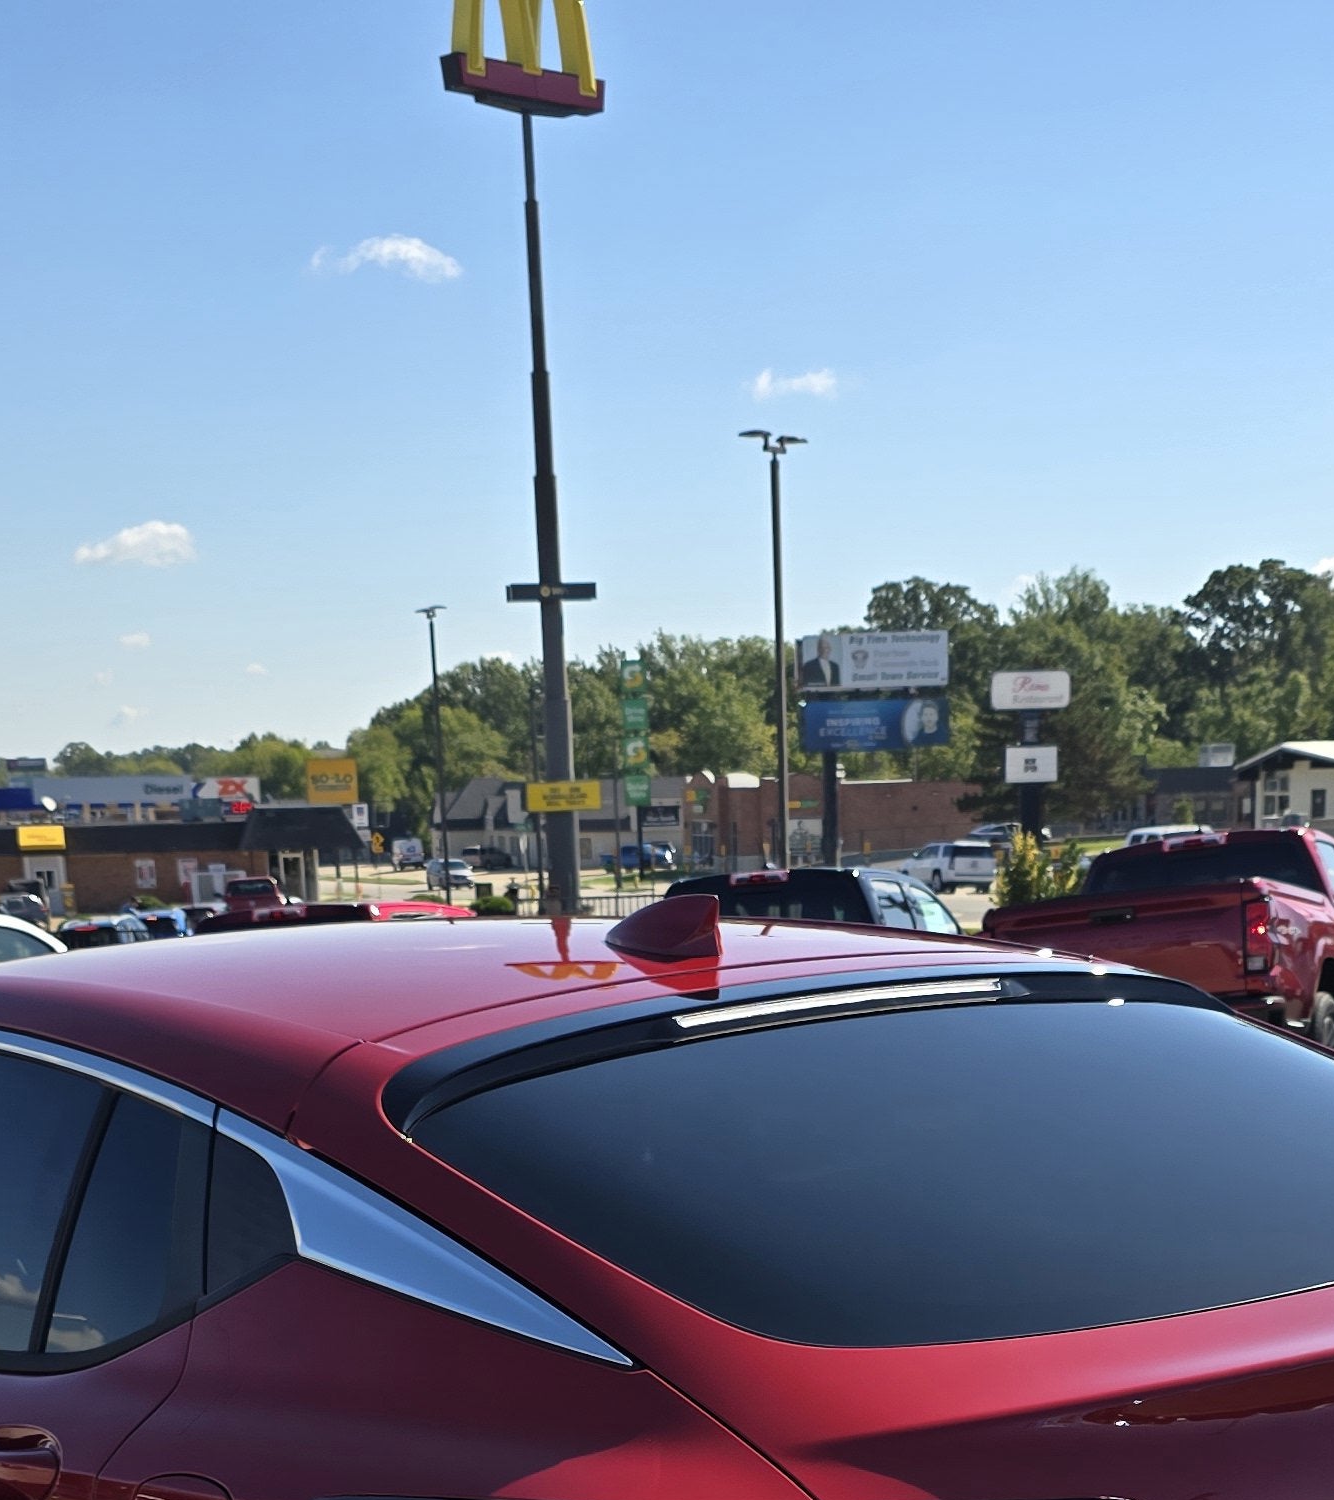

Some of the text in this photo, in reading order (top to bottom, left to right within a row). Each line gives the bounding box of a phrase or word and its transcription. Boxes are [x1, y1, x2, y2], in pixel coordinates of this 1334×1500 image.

[890, 633, 941, 644] Technology
[826, 716, 881, 727] INSPIRING
[819, 726, 887, 737] EXCELLENCE
[144, 783, 184, 795] Diesel
